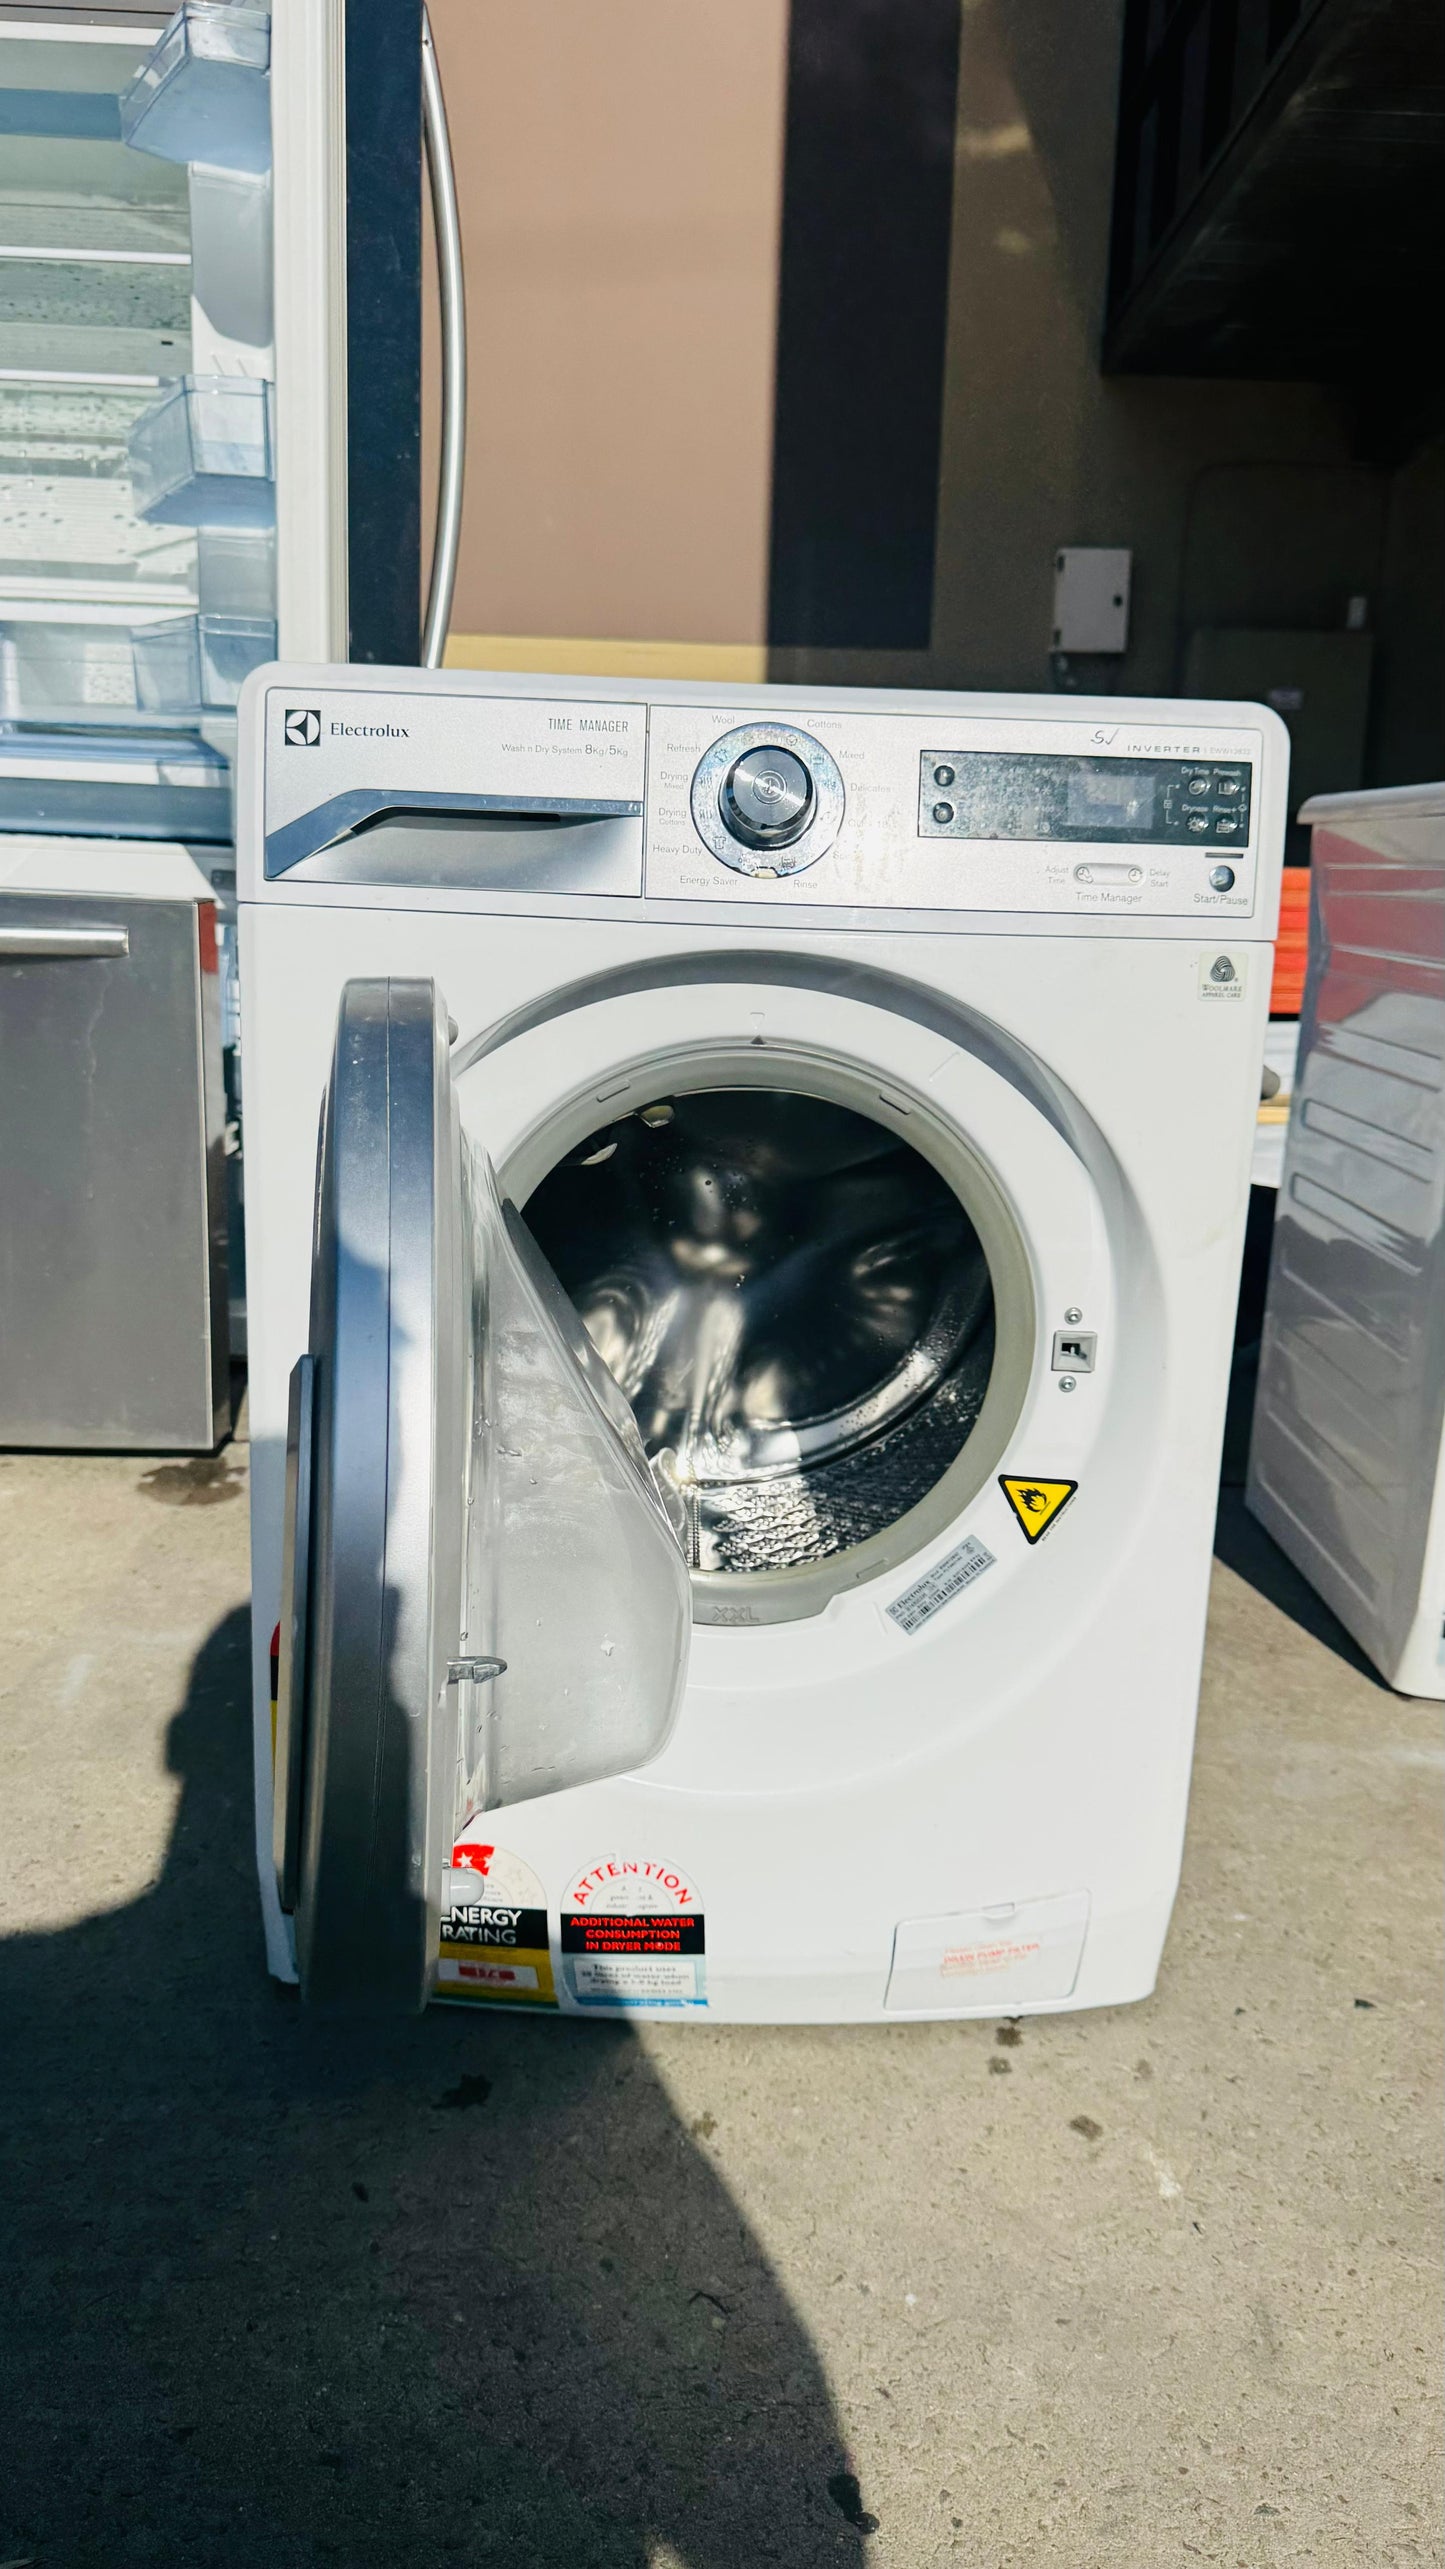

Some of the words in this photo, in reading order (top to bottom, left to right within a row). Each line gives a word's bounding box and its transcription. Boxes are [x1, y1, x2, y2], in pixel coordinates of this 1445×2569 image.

[711, 714, 735, 725] Wool
[806, 719, 842, 730] Cottons
[330, 721, 410, 738] Electrolux
[548, 718, 573, 731] TIME
[579, 719, 629, 733] MANAGER
[501, 743, 526, 753] Wash
[535, 744, 549, 755] Dry
[551, 745, 582, 756] System
[666, 743, 701, 753] Refresh
[1127, 744, 1201, 754] INVERTER
[1181, 766, 1193, 776] Dry
[660, 771, 689, 783] Drying
[658, 807, 687, 818] Drying
[652, 844, 680, 855] Heavy
[682, 845, 703, 857] Duty
[1045, 865, 1070, 876] Adjust
[1149, 868, 1171, 878] Delay
[679, 875, 711, 887] Energy
[712, 876, 738, 886] Saver
[793, 879, 818, 890] Rinse
[1150, 879, 1169, 888] Start
[1076, 891, 1098, 902] Time
[1100, 893, 1143, 905] Manager
[1192, 893, 1248, 906] Start/Pause
[711, 1606, 760, 1623] XXL
[573, 1861, 693, 1906] ATTENTION
[570, 1917, 650, 1928] ADDITIONAL
[651, 1918, 695, 1928] WATER
[442, 1924, 517, 1945] RATING
[585, 1929, 680, 1939] CONSUMPTION
[585, 1941, 599, 1950] IN
[601, 1941, 641, 1951] DRYER
[643, 1942, 681, 1951] MODE
